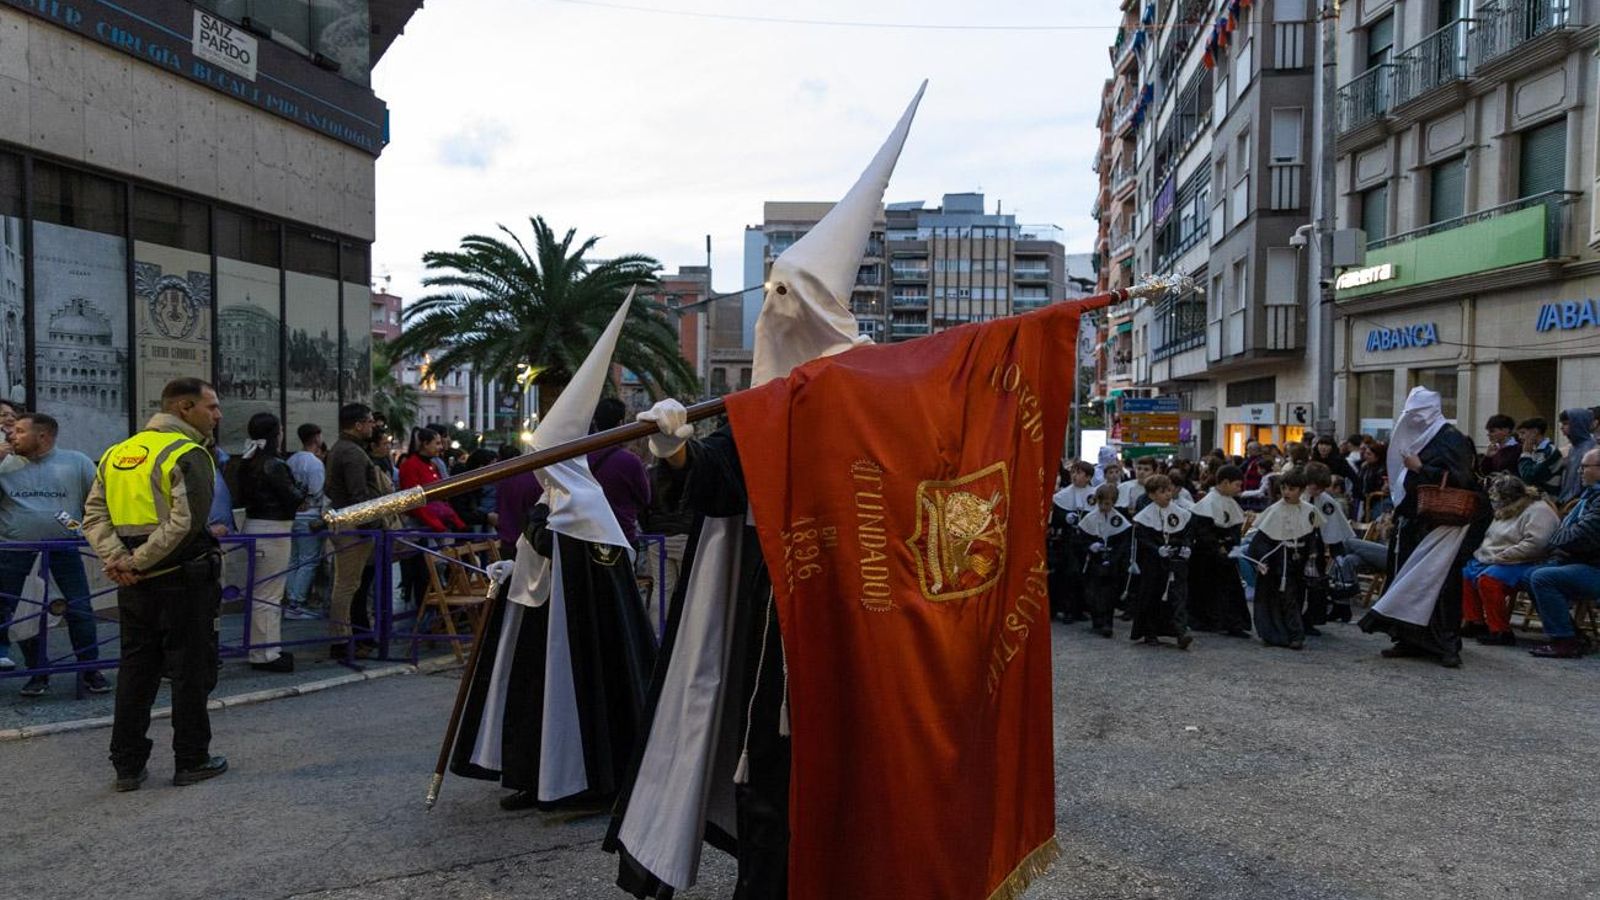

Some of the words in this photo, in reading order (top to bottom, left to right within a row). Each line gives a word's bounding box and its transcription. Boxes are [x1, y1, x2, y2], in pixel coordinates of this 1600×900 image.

[200, 14, 232, 42] SAIZ
[200, 29, 250, 65] PARDO
[10, 489, 21, 498] LA
[22, 490, 67, 498] GARROCHA
[792, 516, 822, 580] 1896
